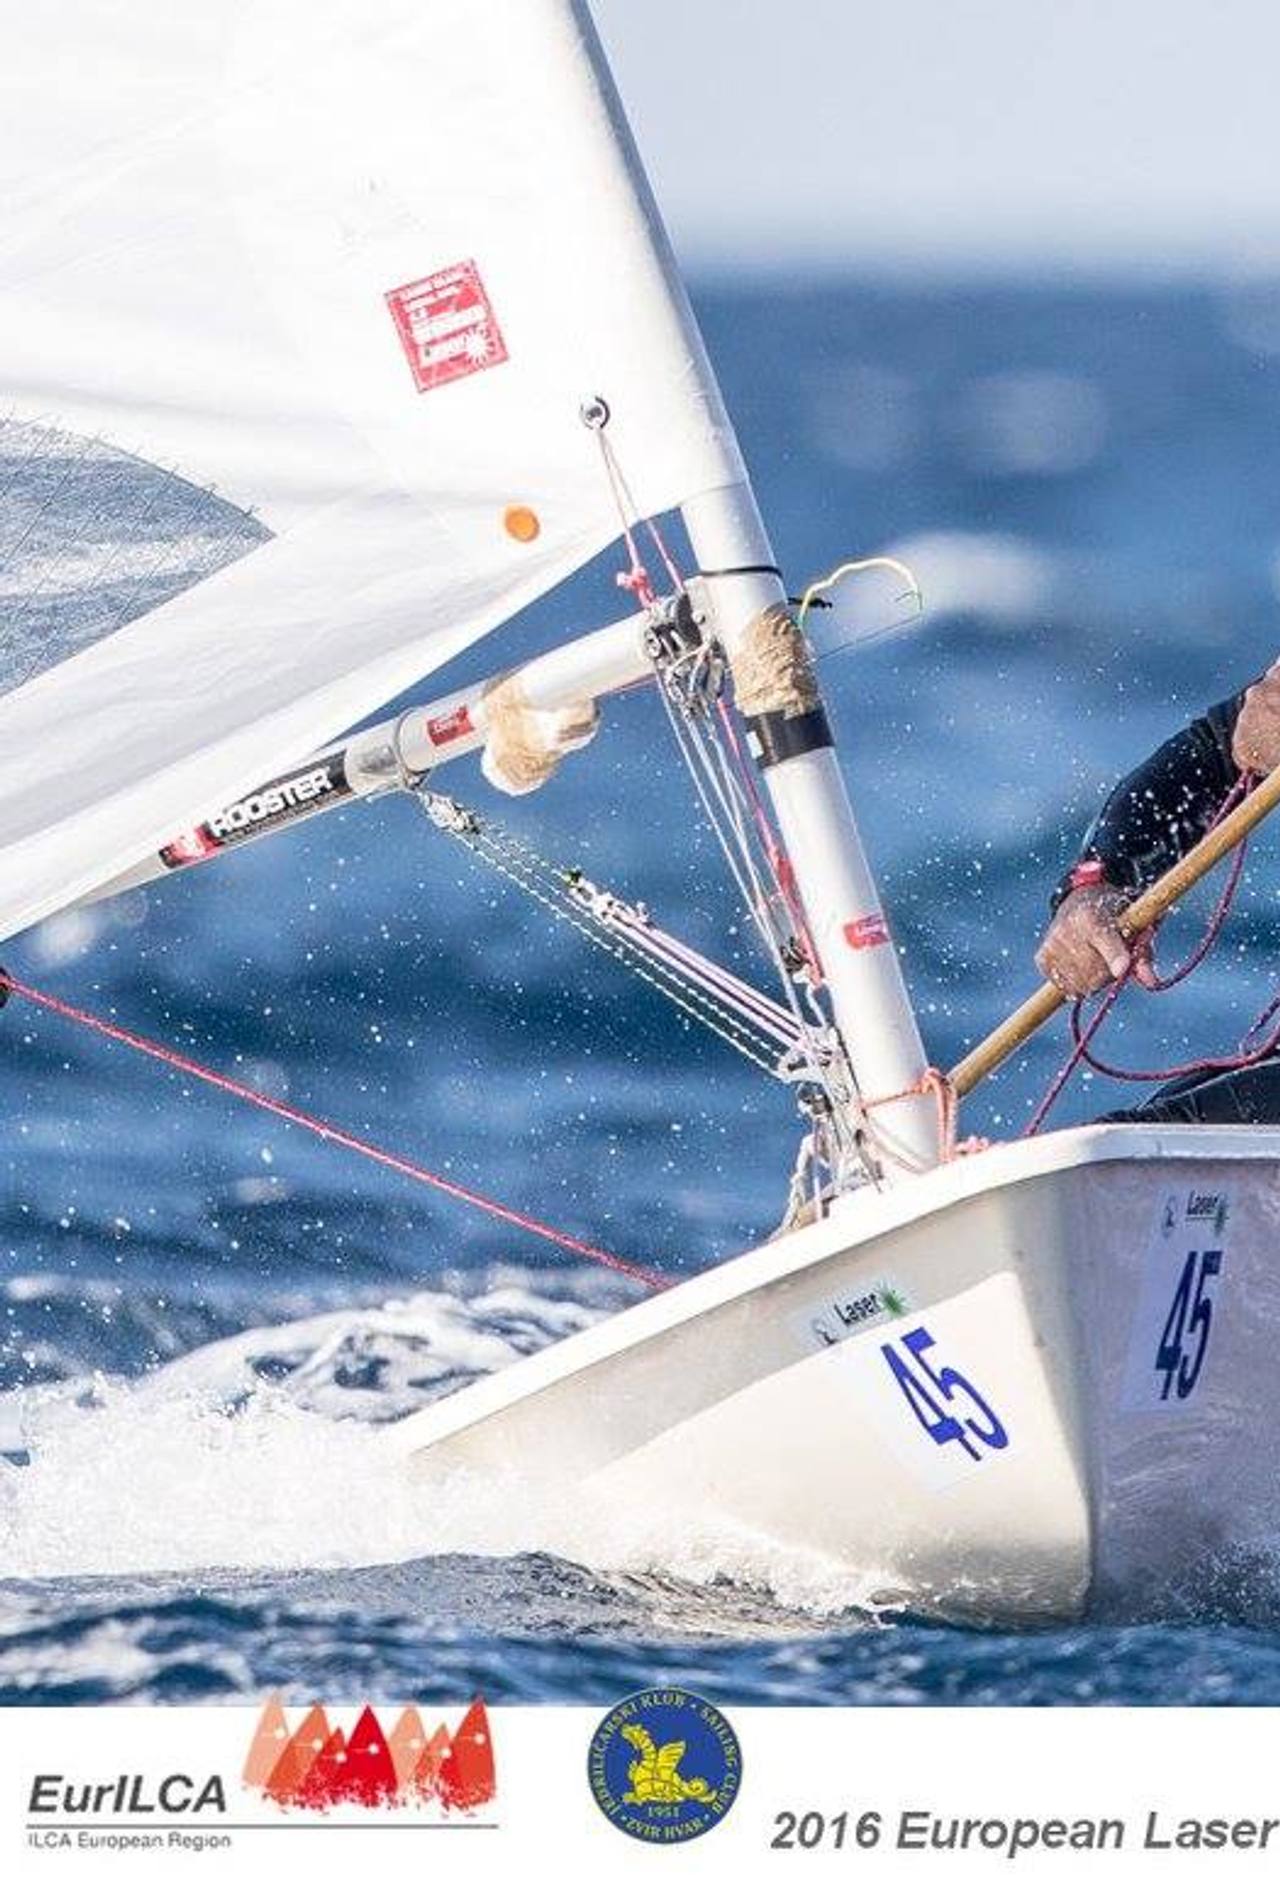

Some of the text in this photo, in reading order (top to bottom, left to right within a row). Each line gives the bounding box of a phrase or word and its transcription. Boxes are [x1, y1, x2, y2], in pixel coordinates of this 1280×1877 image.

[209, 765, 334, 837] ROOSTER
[833, 1292, 882, 1326] Laser
[1155, 1250, 1223, 1401] 45
[879, 1325, 1009, 1462] 45
